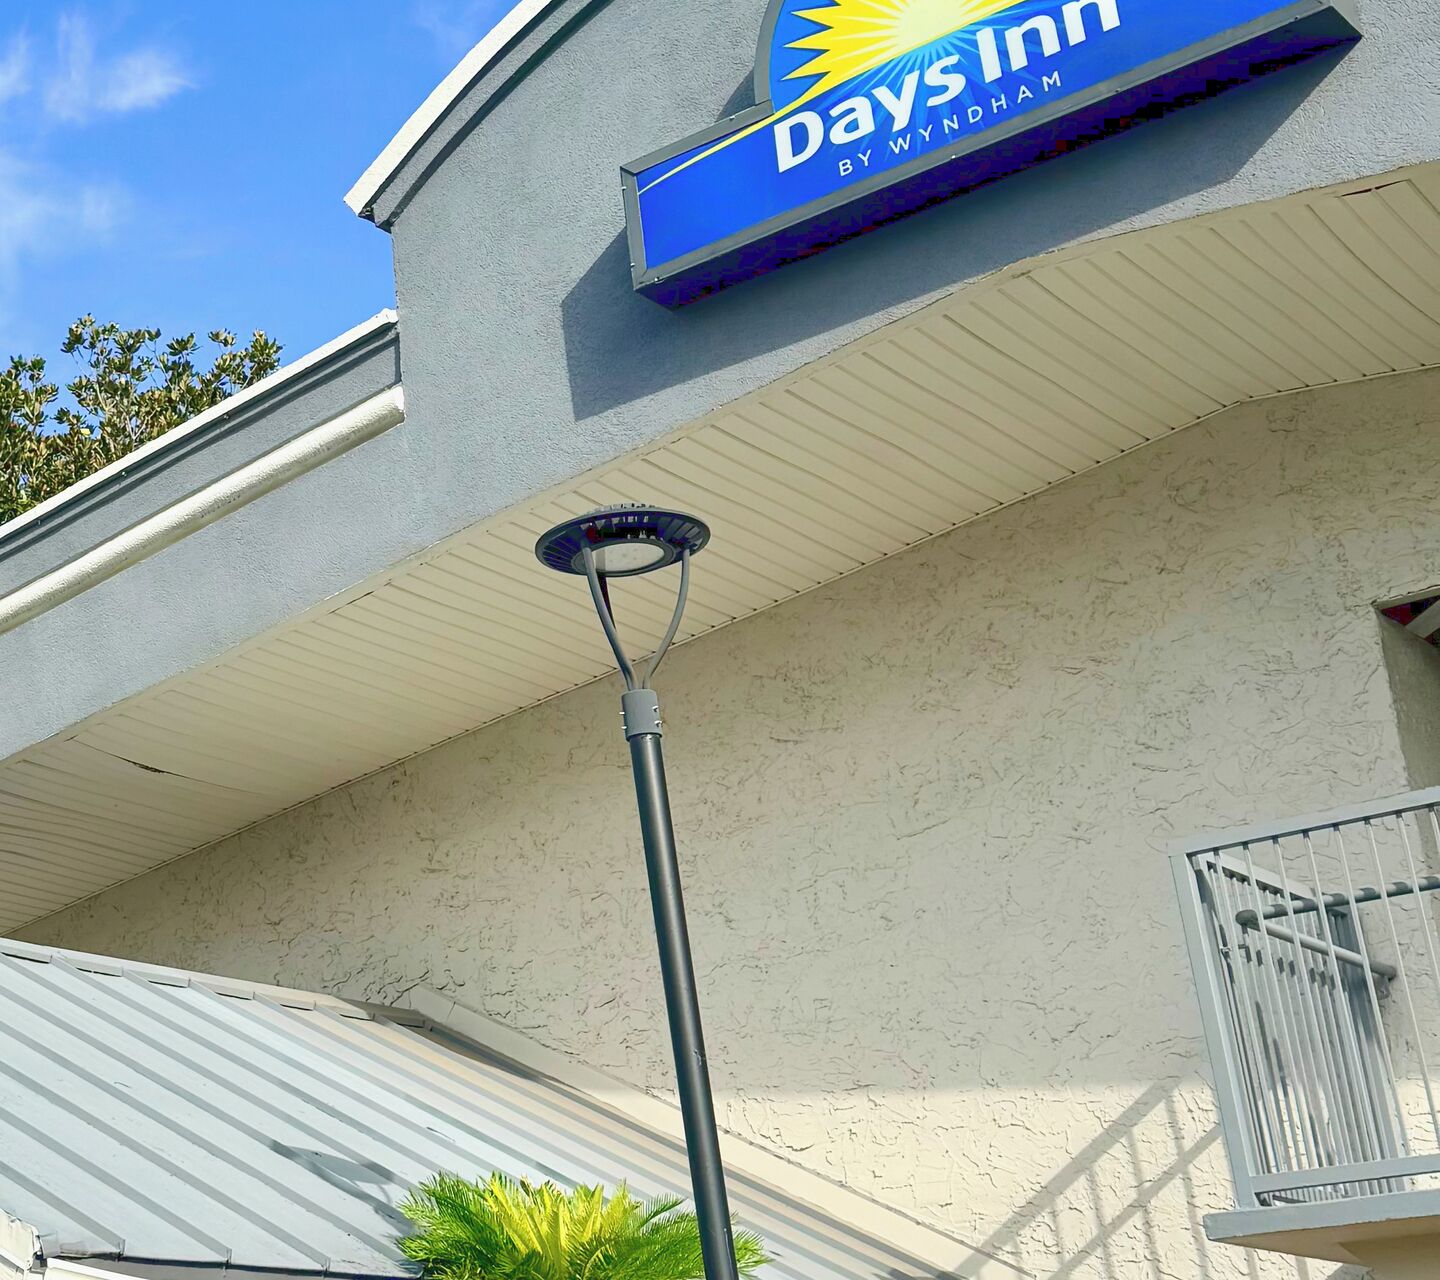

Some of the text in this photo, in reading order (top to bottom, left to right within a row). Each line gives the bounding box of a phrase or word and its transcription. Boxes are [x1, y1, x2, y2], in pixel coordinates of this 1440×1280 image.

[773, 52, 967, 174] Days
[838, 72, 1062, 177] BY WYNDHAM
